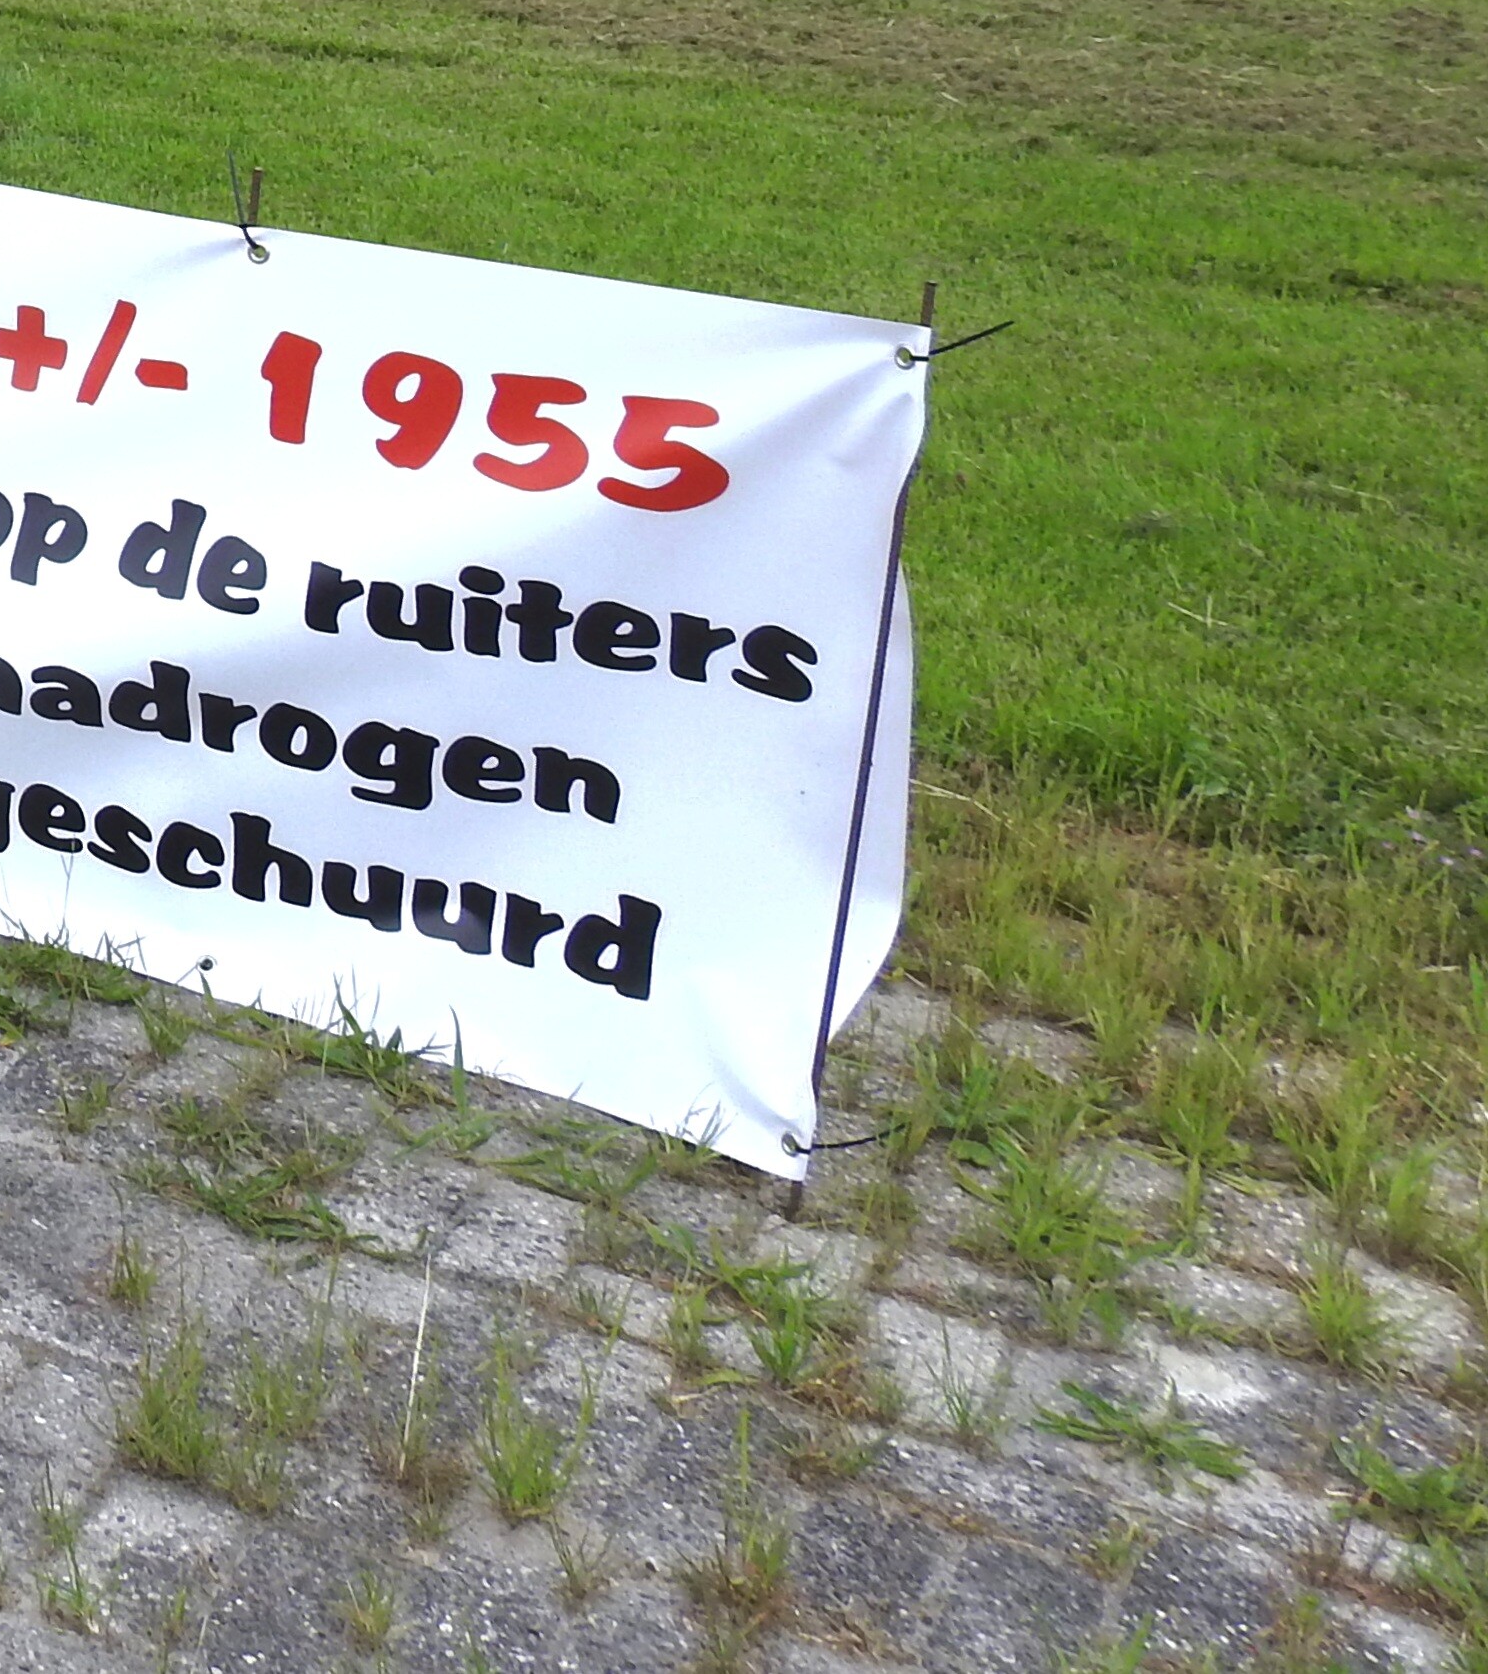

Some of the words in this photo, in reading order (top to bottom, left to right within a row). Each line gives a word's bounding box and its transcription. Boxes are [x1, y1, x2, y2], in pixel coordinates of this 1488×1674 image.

[261, 332, 729, 512] 1955
[119, 499, 267, 615] de
[305, 562, 817, 702] ruiters
